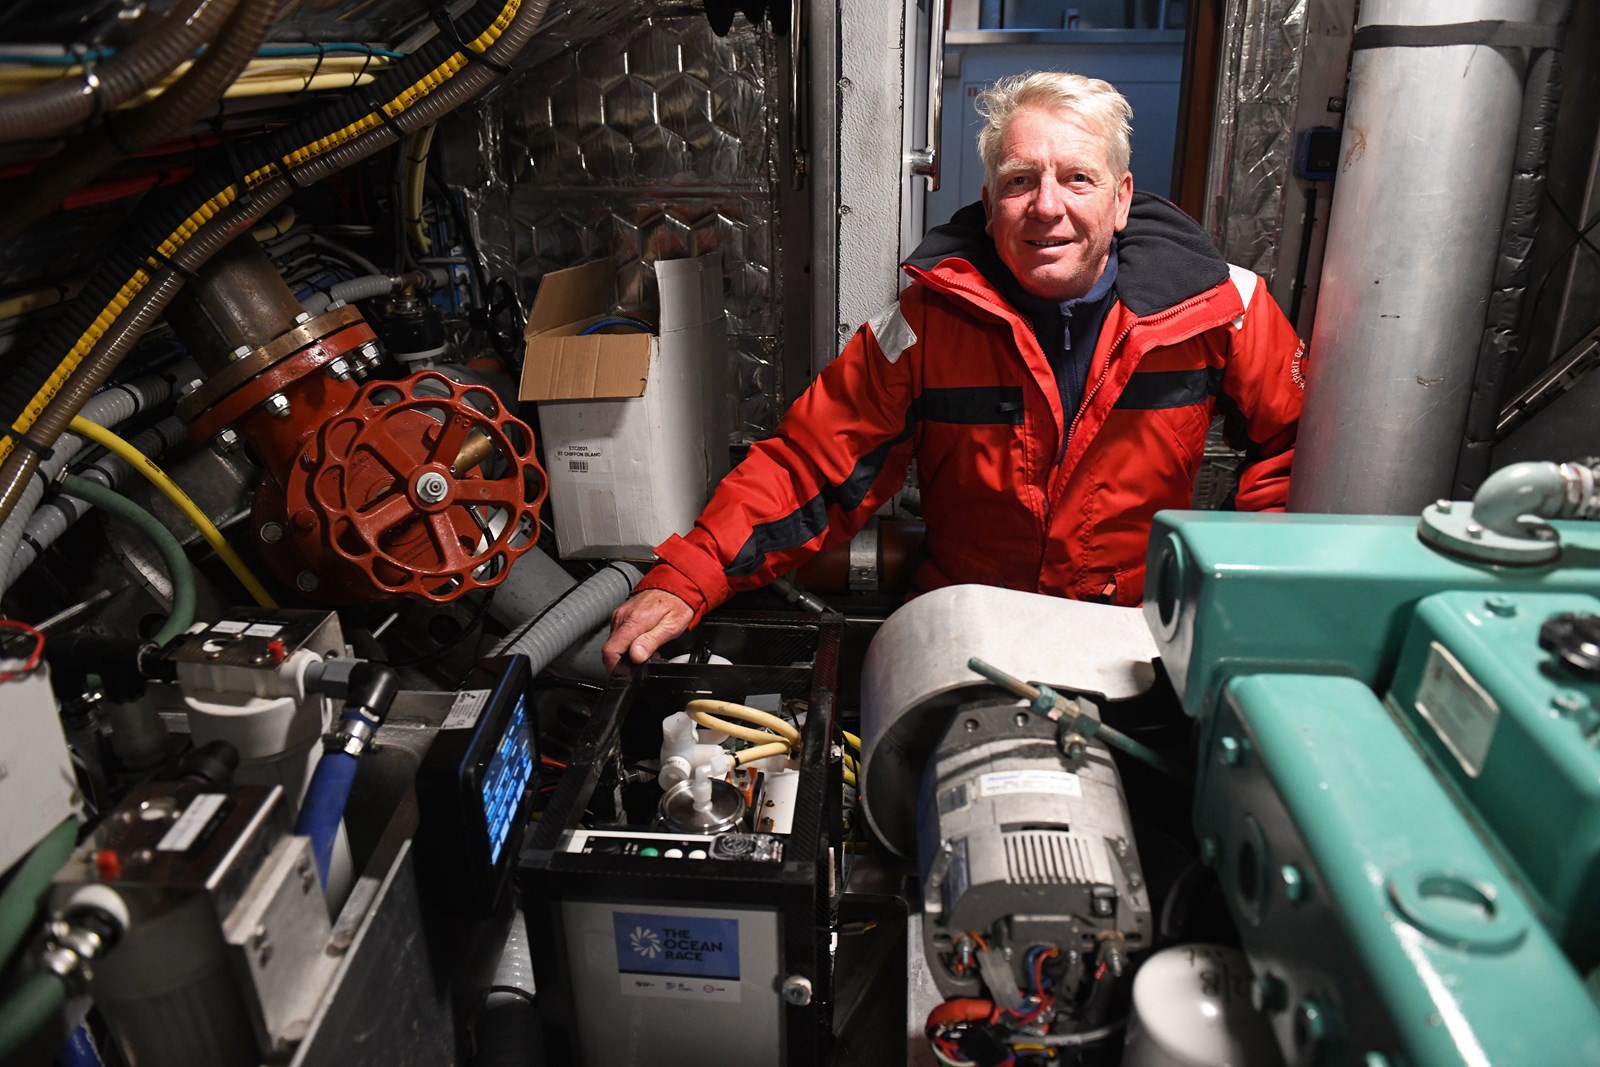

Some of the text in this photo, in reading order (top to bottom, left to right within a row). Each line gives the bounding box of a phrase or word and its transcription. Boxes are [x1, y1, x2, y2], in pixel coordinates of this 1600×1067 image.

[1295, 347, 1304, 359] OF
[1291, 360, 1303, 384] SPIRIT
[663, 928, 690, 939] THE
[663, 939, 723, 952] OCEAN
[665, 951, 703, 962] RACE
